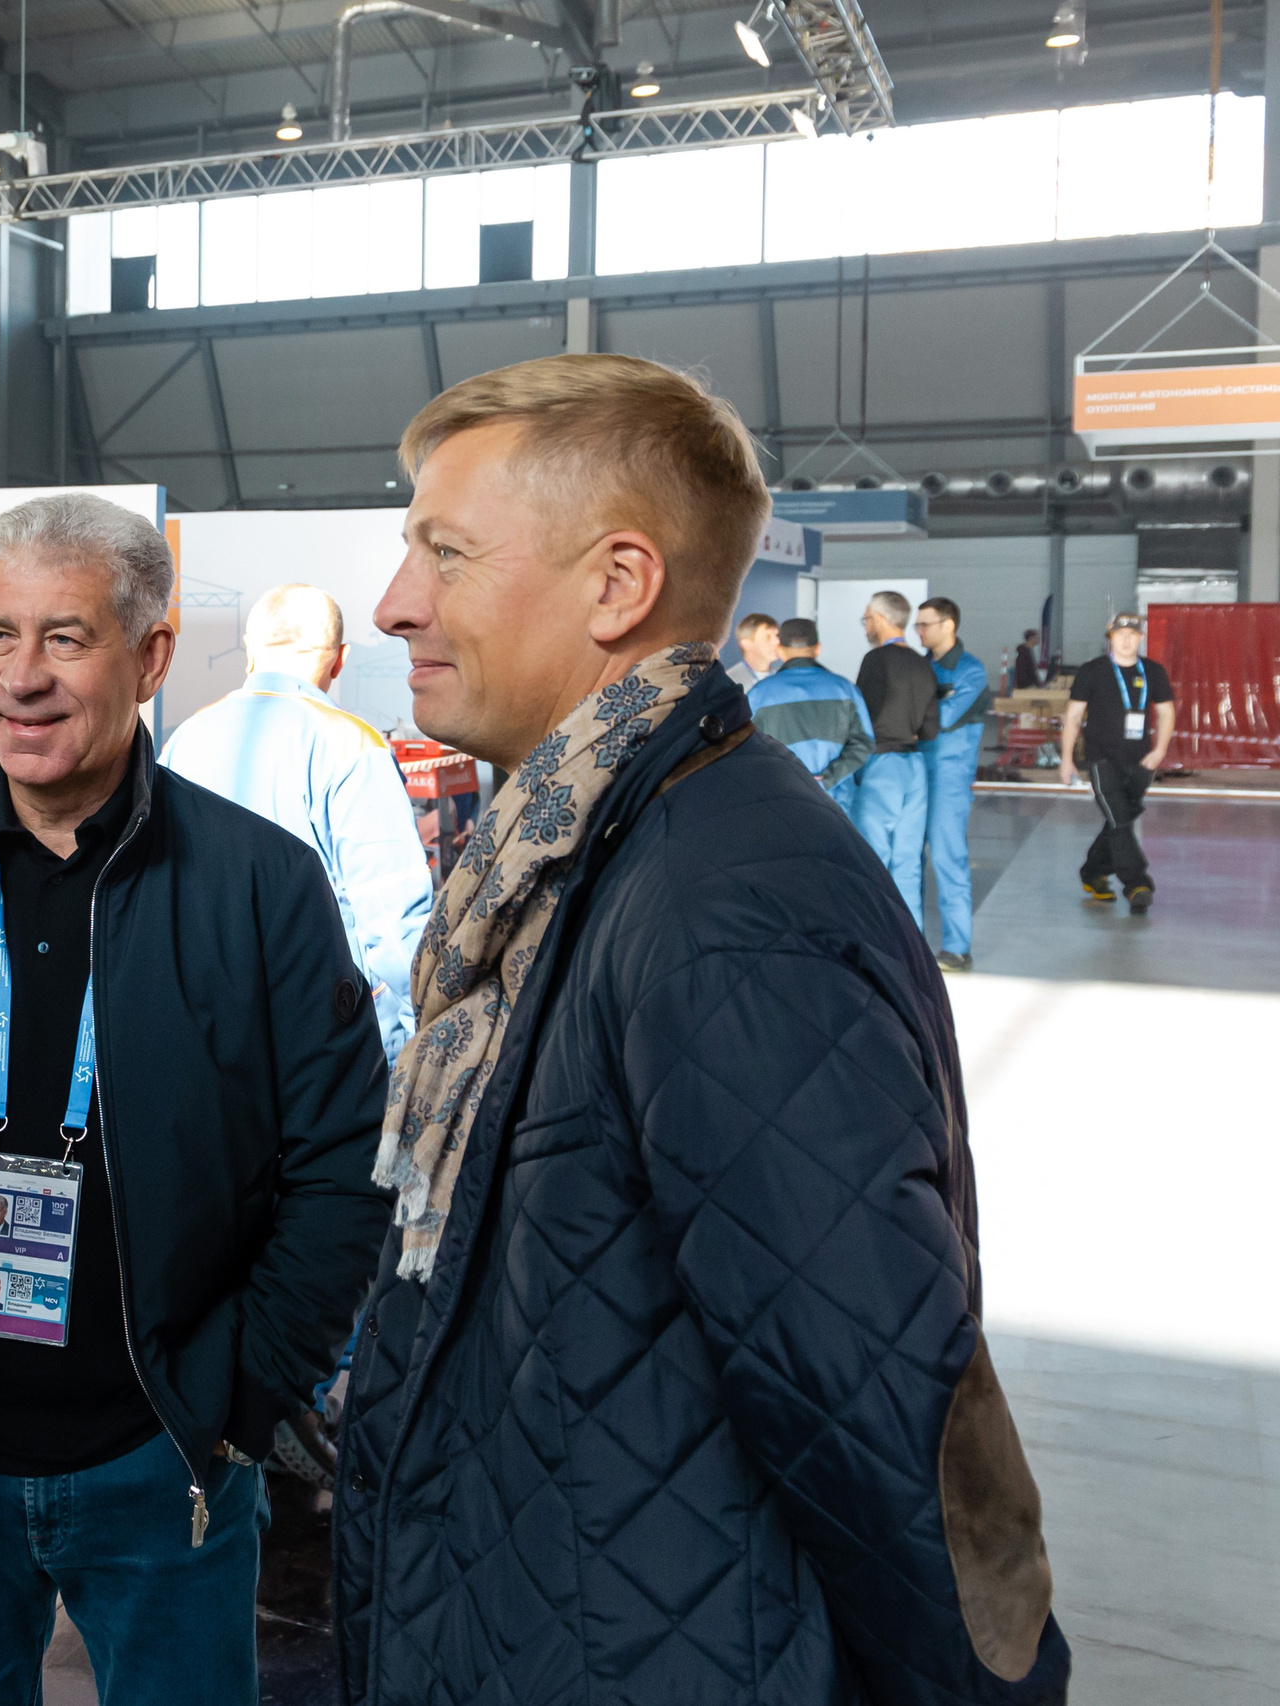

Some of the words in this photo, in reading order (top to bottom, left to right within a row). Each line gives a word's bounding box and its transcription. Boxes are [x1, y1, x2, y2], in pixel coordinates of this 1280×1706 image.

[1086, 391, 1137, 401] МОНТАЖ
[1140, 385, 1222, 399] АВТОНОМНОЙ
[1085, 402, 1156, 414] ОТОПЛЕНИЯ
[14, 1246, 27, 1254] VIP
